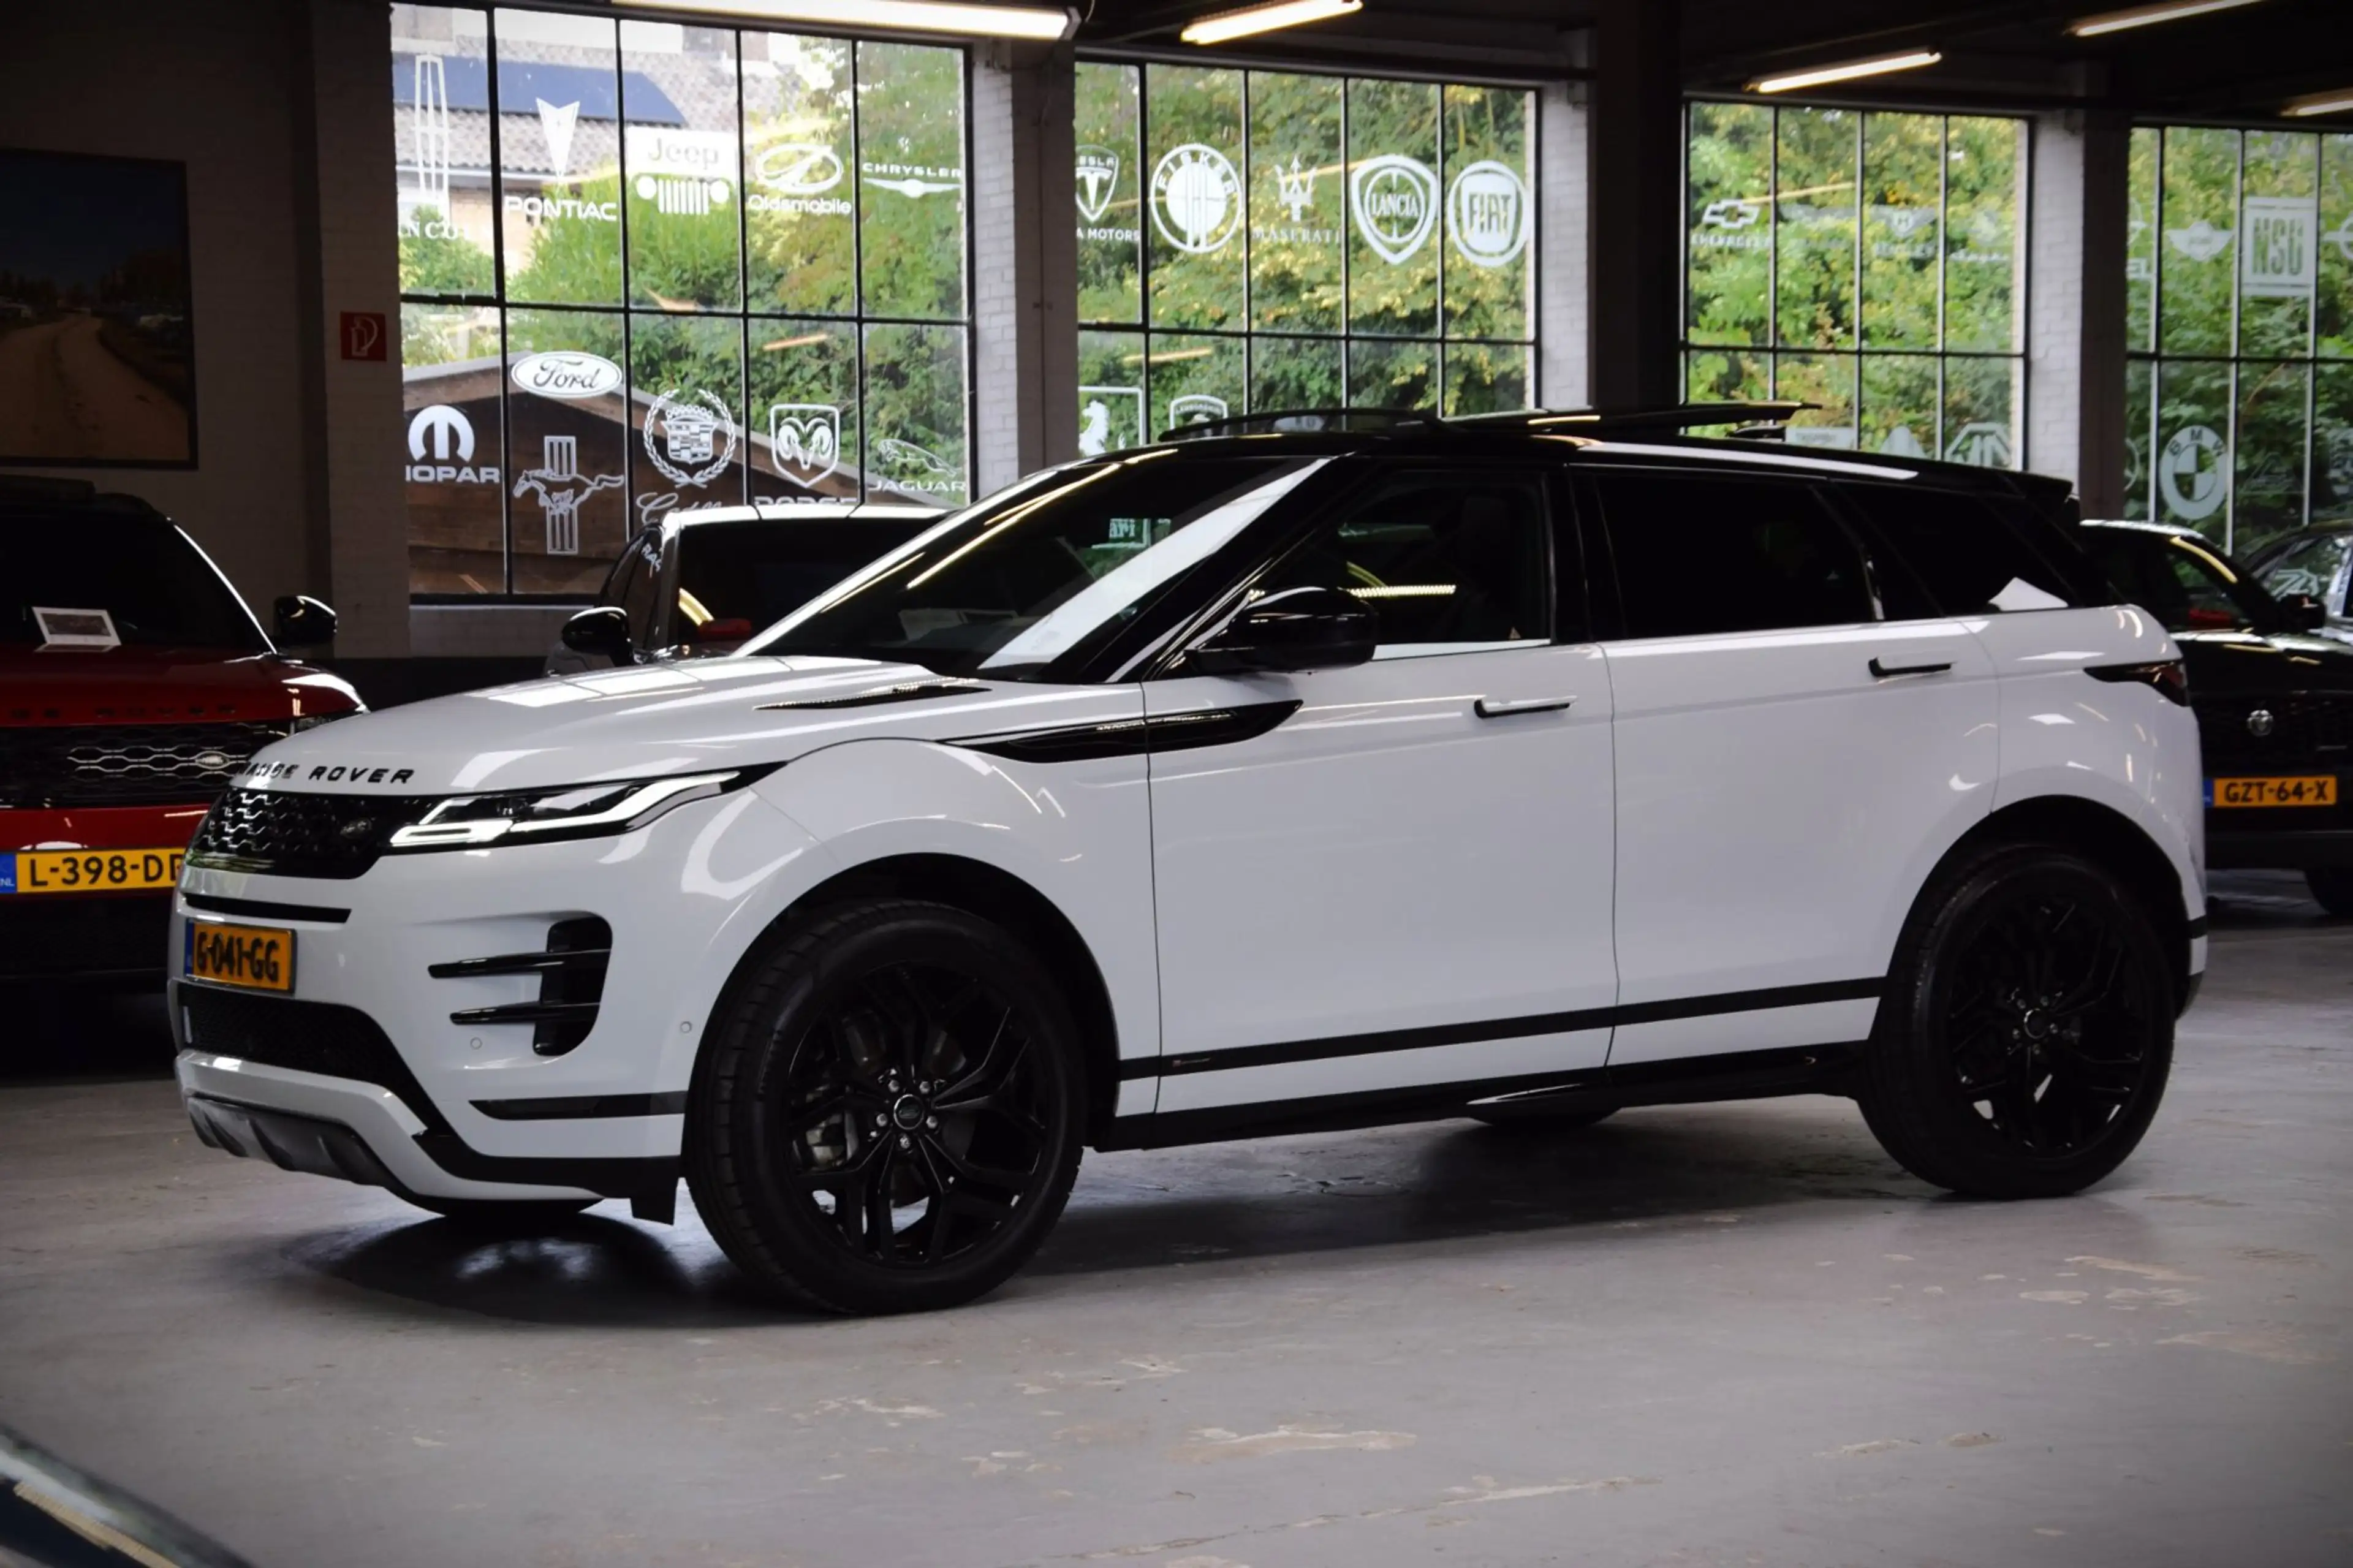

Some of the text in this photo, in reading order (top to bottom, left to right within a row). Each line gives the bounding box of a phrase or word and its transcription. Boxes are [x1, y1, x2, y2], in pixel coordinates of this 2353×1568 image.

[647, 137, 719, 170] Jeep
[1078, 155, 1115, 168] ESLA
[862, 162, 963, 178] CHRYSLER
[504, 195, 617, 221] PONTIAC
[748, 195, 852, 216] Oldsmobile
[1468, 191, 1512, 235] FIAT
[1088, 227, 1140, 242] MOTORS
[2253, 216, 2303, 275] NSU
[532, 359, 599, 389] Ford
[405, 464, 500, 484] OPAR
[867, 480, 966, 492] JAGUAR
[308, 765, 415, 784] ROVER
[2224, 780, 2328, 803] GZT-64-X
